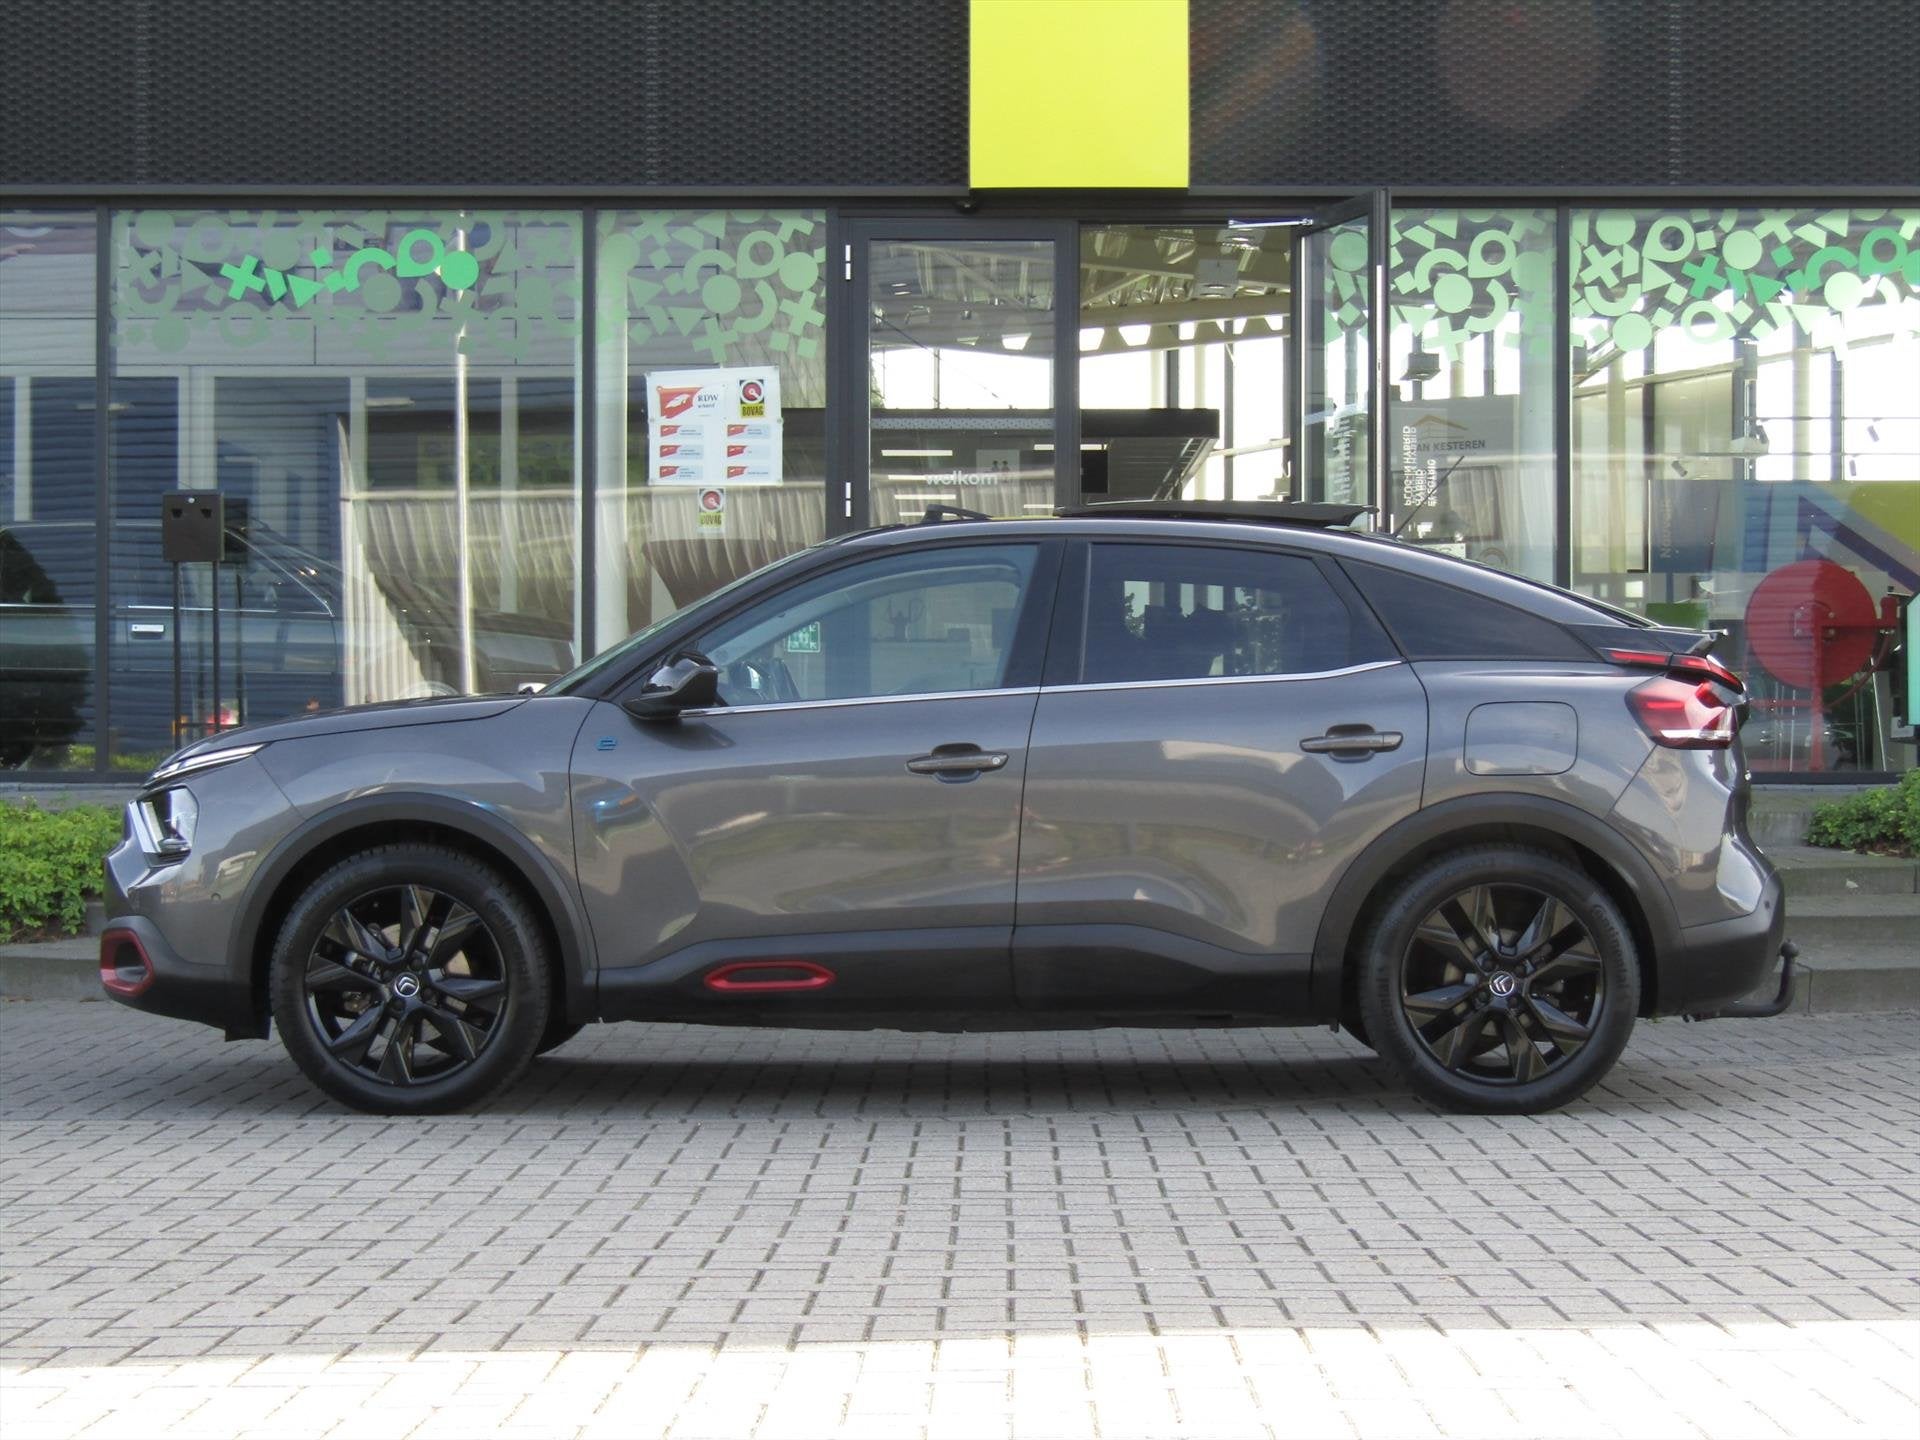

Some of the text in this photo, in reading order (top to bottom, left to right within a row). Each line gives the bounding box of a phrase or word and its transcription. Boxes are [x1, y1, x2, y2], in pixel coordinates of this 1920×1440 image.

[697, 393, 719, 402] RDW
[742, 405, 764, 417] BOVAG
[1433, 440, 1486, 451] KESTEREN
[926, 470, 998, 486] welkom
[700, 513, 722, 525] BOVAG
